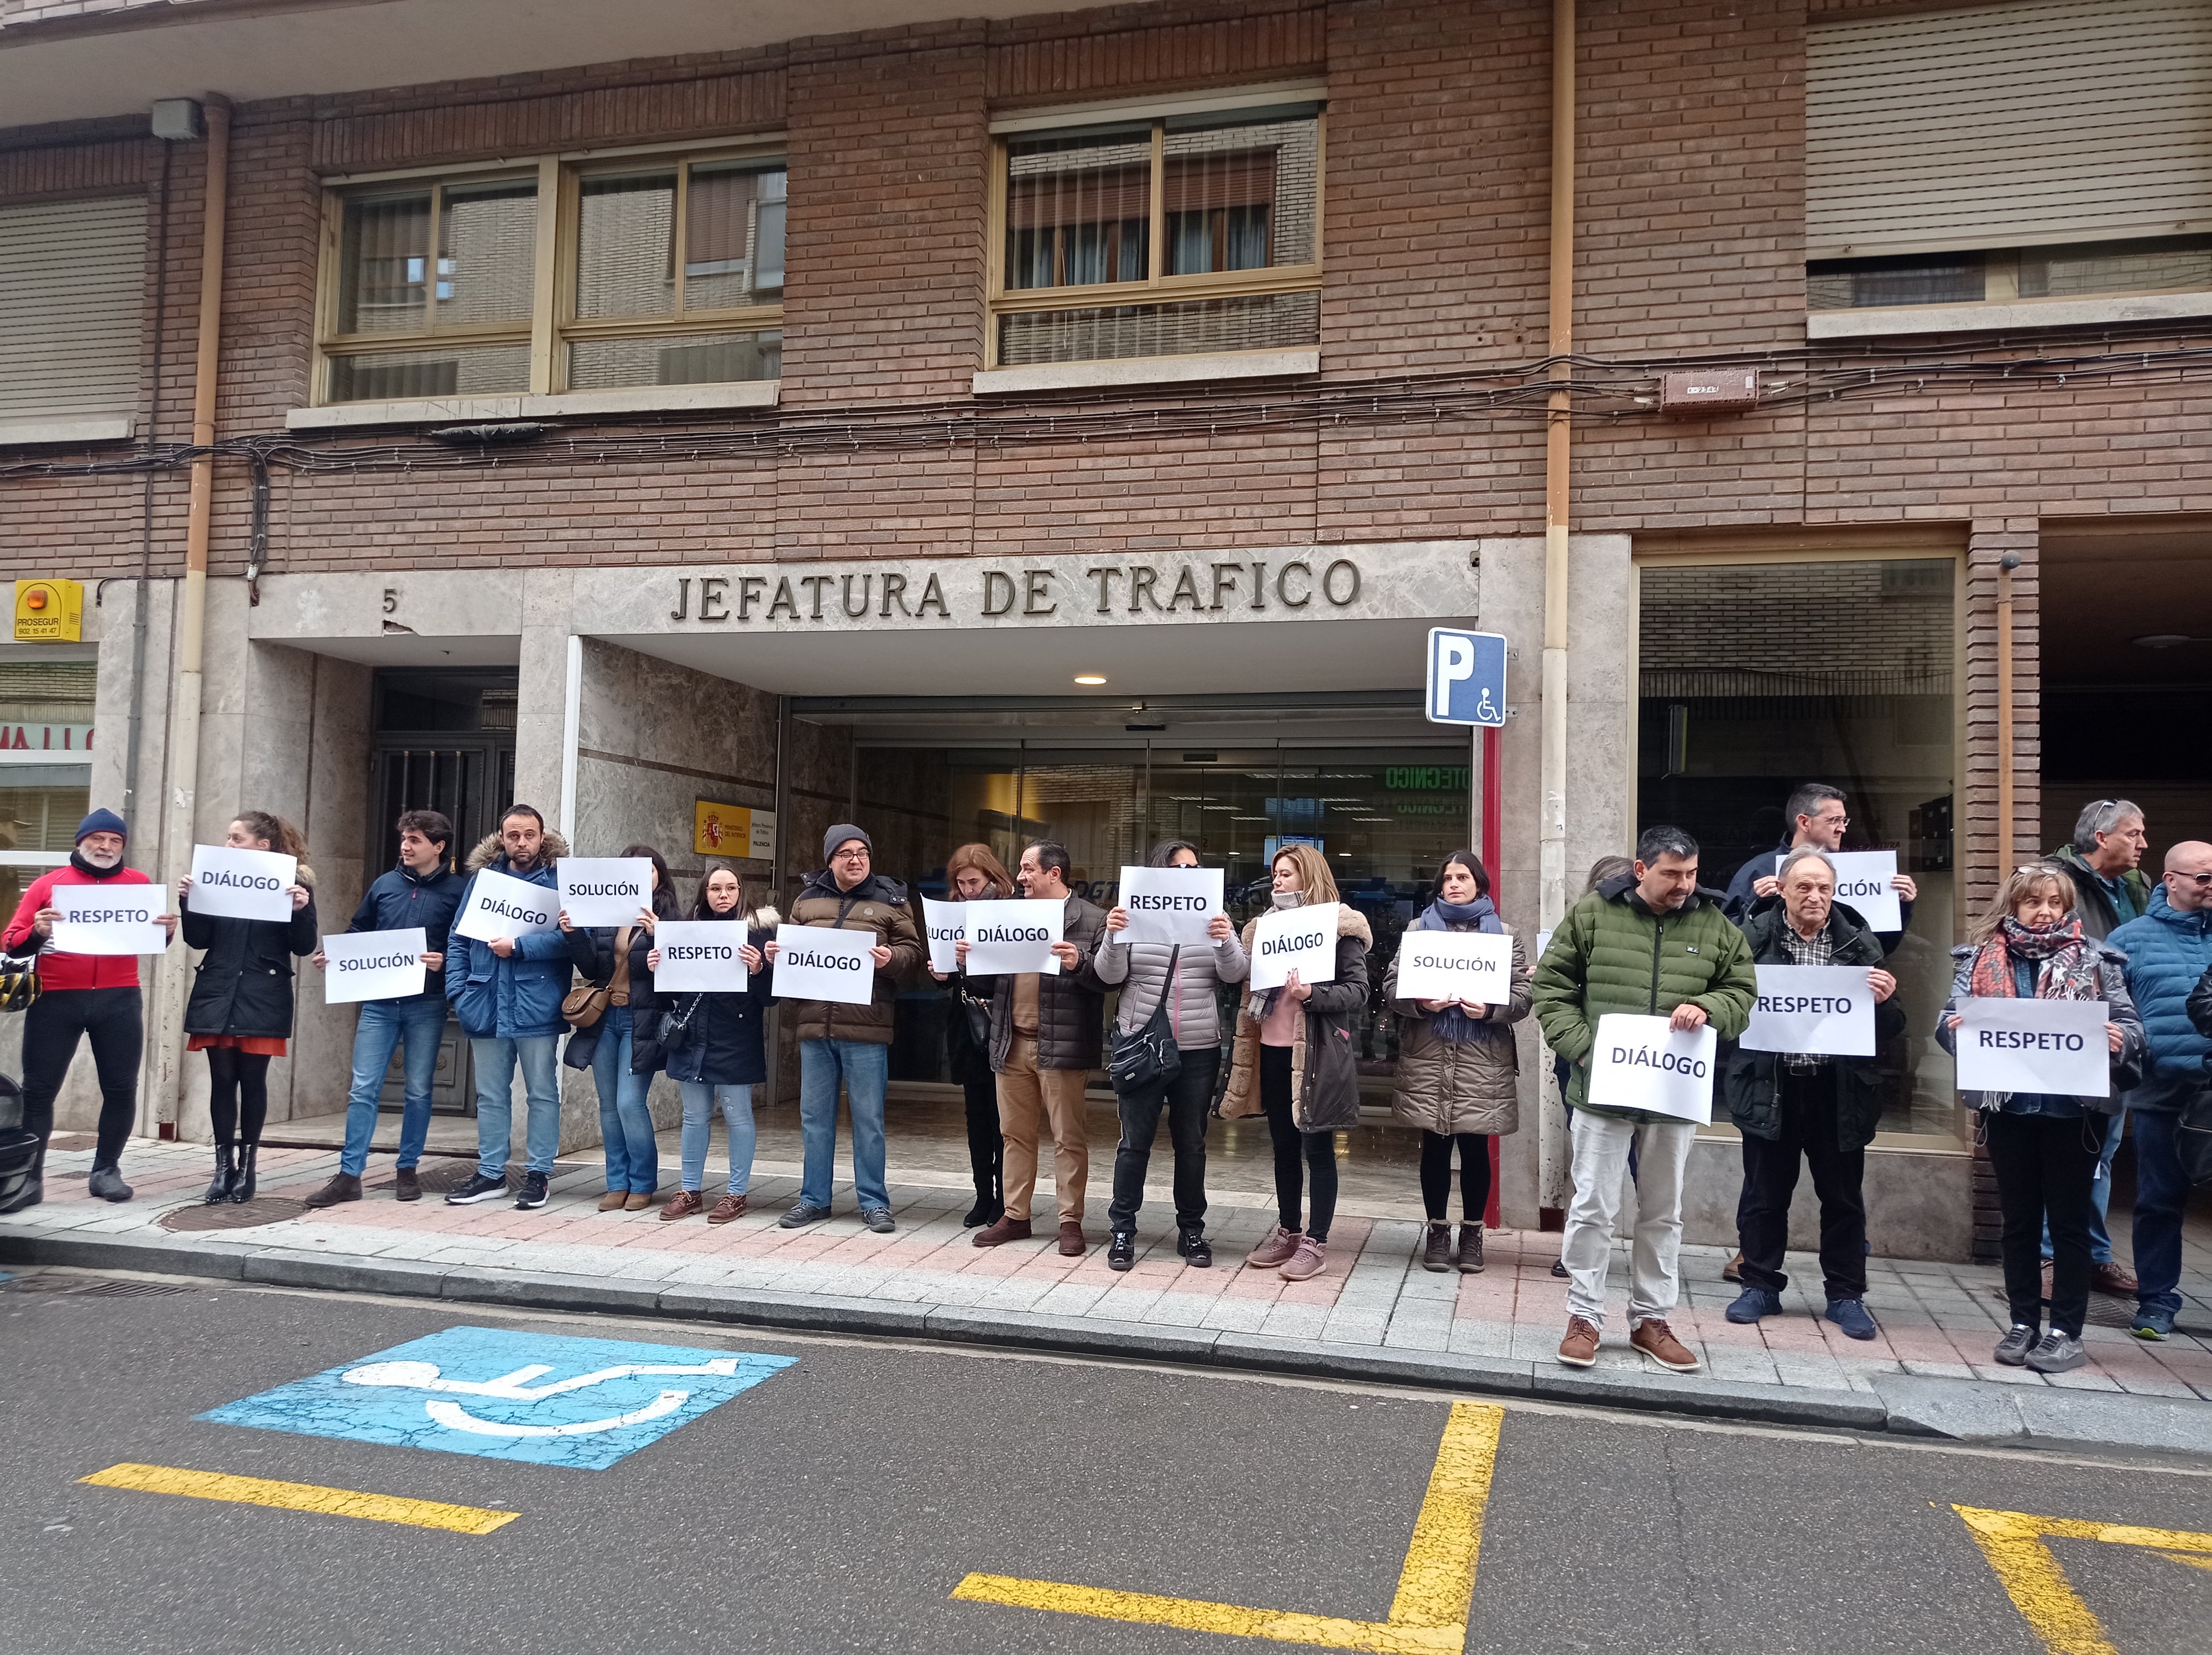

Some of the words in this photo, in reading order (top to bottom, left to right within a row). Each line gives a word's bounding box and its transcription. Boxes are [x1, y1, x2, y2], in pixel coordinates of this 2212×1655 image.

[671, 573, 951, 620] JEFATURA
[981, 570, 1057, 616] DE
[1087, 559, 1361, 613] TRAFICO
[383, 589, 397, 614] 5
[18, 618, 59, 626] PROSEGUR
[1436, 634, 1474, 716] P
[1865, 841, 1901, 850] PINTURA
[202, 872, 279, 891] DIÁLOGO
[569, 879, 638, 896] SOLUCIÓN
[1130, 895, 1207, 911] RESPETO
[70, 910, 148, 923] RESPETO
[481, 898, 548, 926] DIÁLOGO
[926, 925, 964, 940] LUCIÓ
[978, 928, 1048, 942] DIÁLOGO
[1262, 933, 1323, 955] DIÁLOGO
[668, 946, 732, 960] RESPETO
[788, 950, 860, 971] DIÁLOGO
[340, 954, 414, 971] SOLUCIÓN
[1413, 956, 1495, 972] SOLUCIÓN
[1758, 996, 1851, 1014] RESPETO
[1980, 1031, 2083, 1051] RESPETO
[1612, 1047, 1705, 1078] DIÁLOGO
